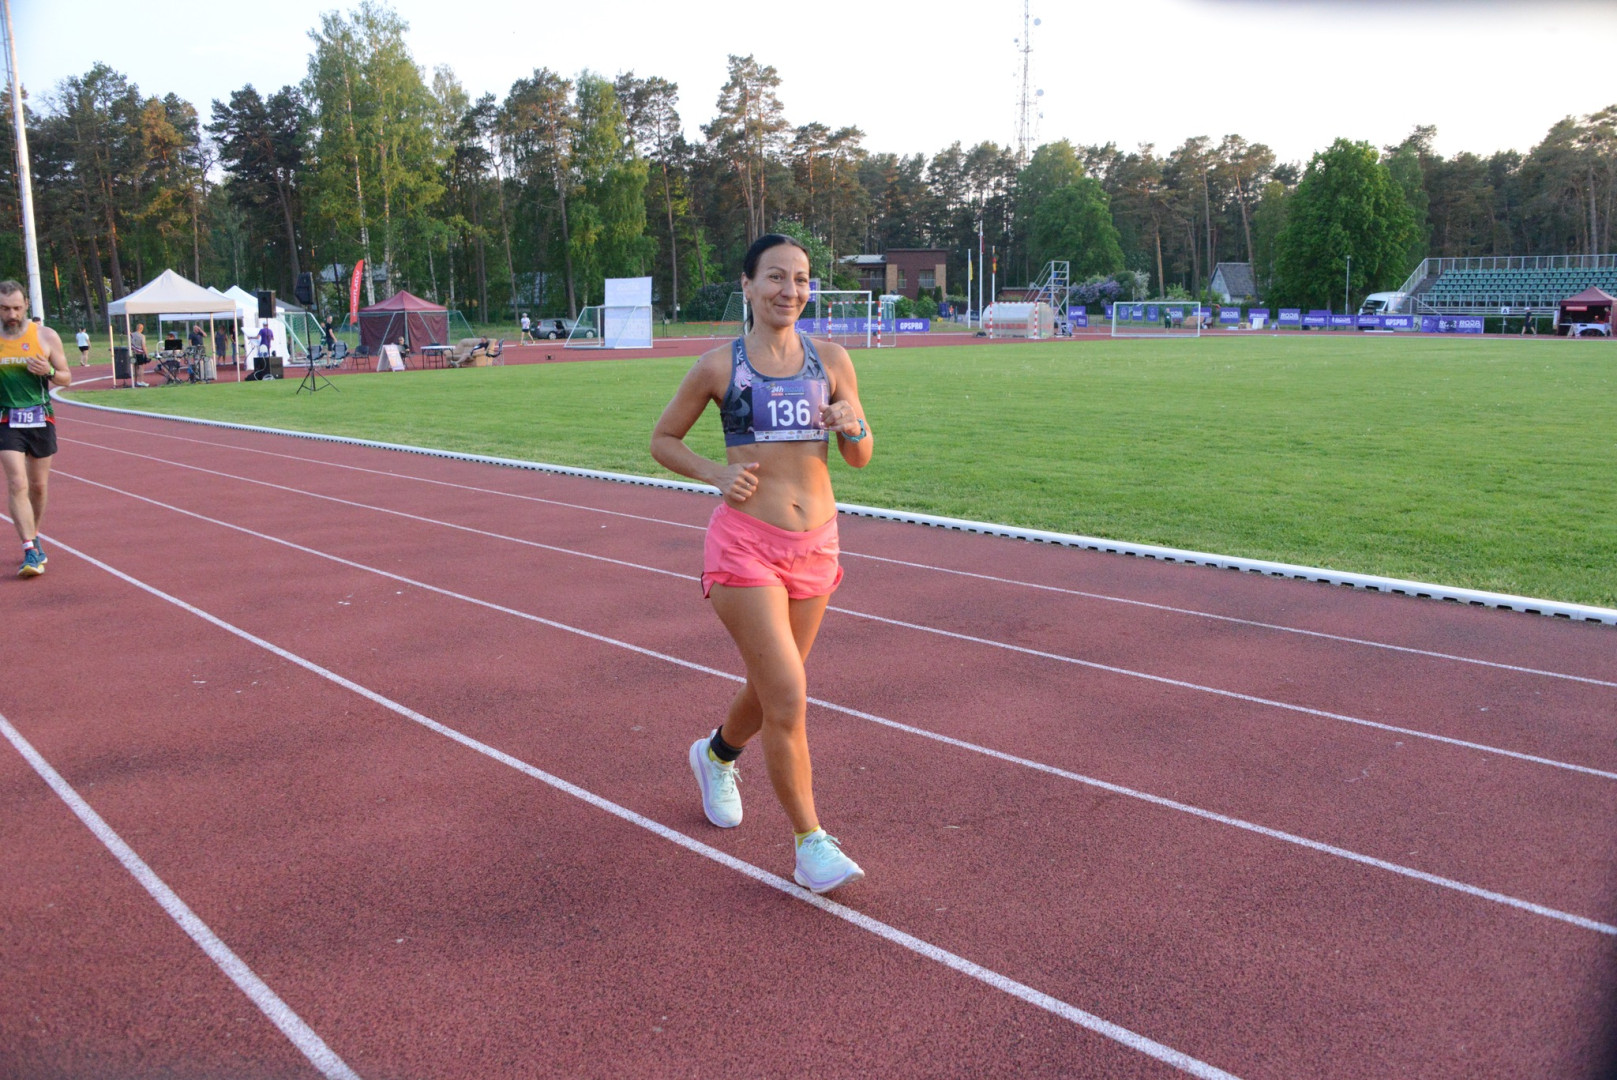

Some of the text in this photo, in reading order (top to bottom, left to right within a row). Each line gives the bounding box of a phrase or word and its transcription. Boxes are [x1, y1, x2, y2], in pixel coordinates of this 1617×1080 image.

[900, 322, 923, 330] GPSPRO
[0, 356, 28, 365] IETUV
[17, 412, 34, 423] 119
[767, 399, 811, 428] 136
